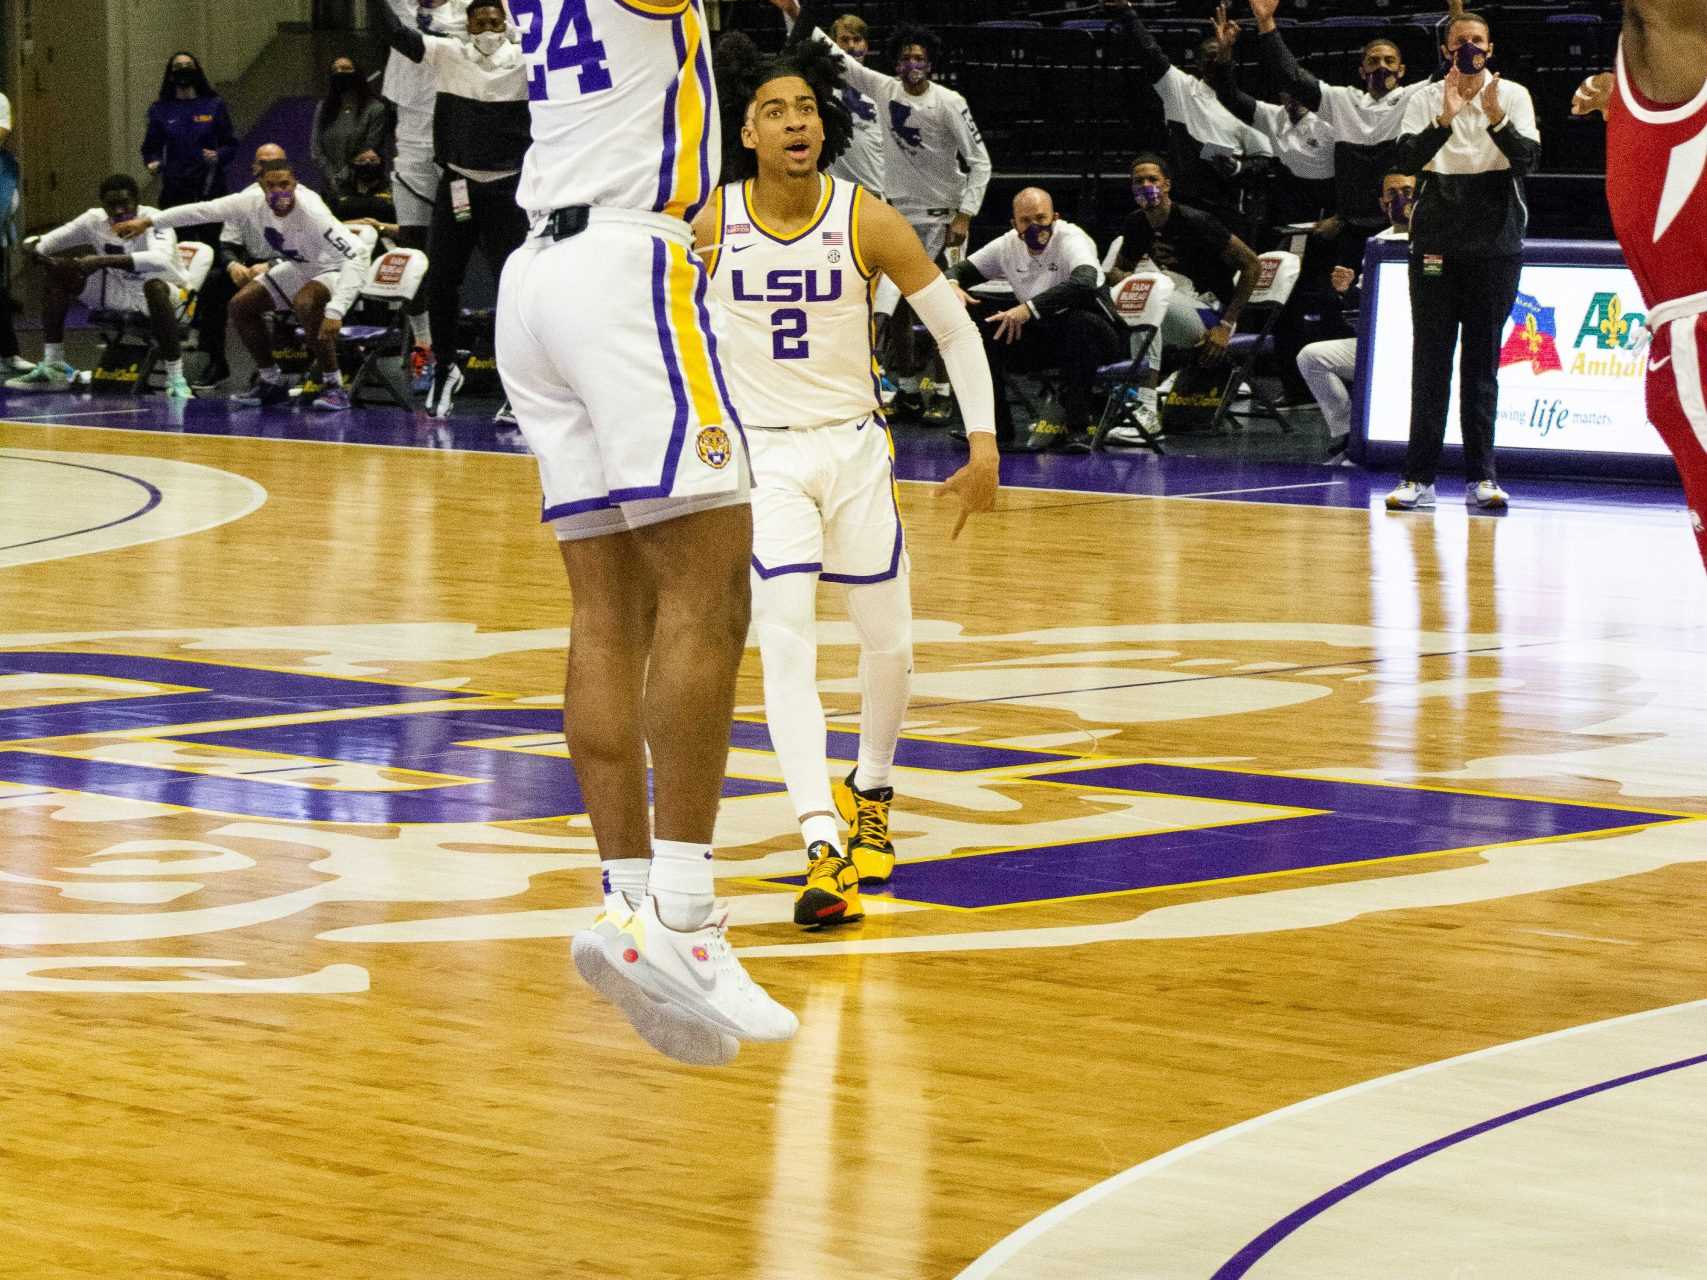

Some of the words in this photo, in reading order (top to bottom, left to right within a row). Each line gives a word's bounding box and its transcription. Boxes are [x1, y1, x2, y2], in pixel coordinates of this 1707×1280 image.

[323, 228, 356, 260] LSU
[731, 269, 842, 303] LSU
[771, 308, 809, 360] 2
[1529, 399, 1568, 437] life
